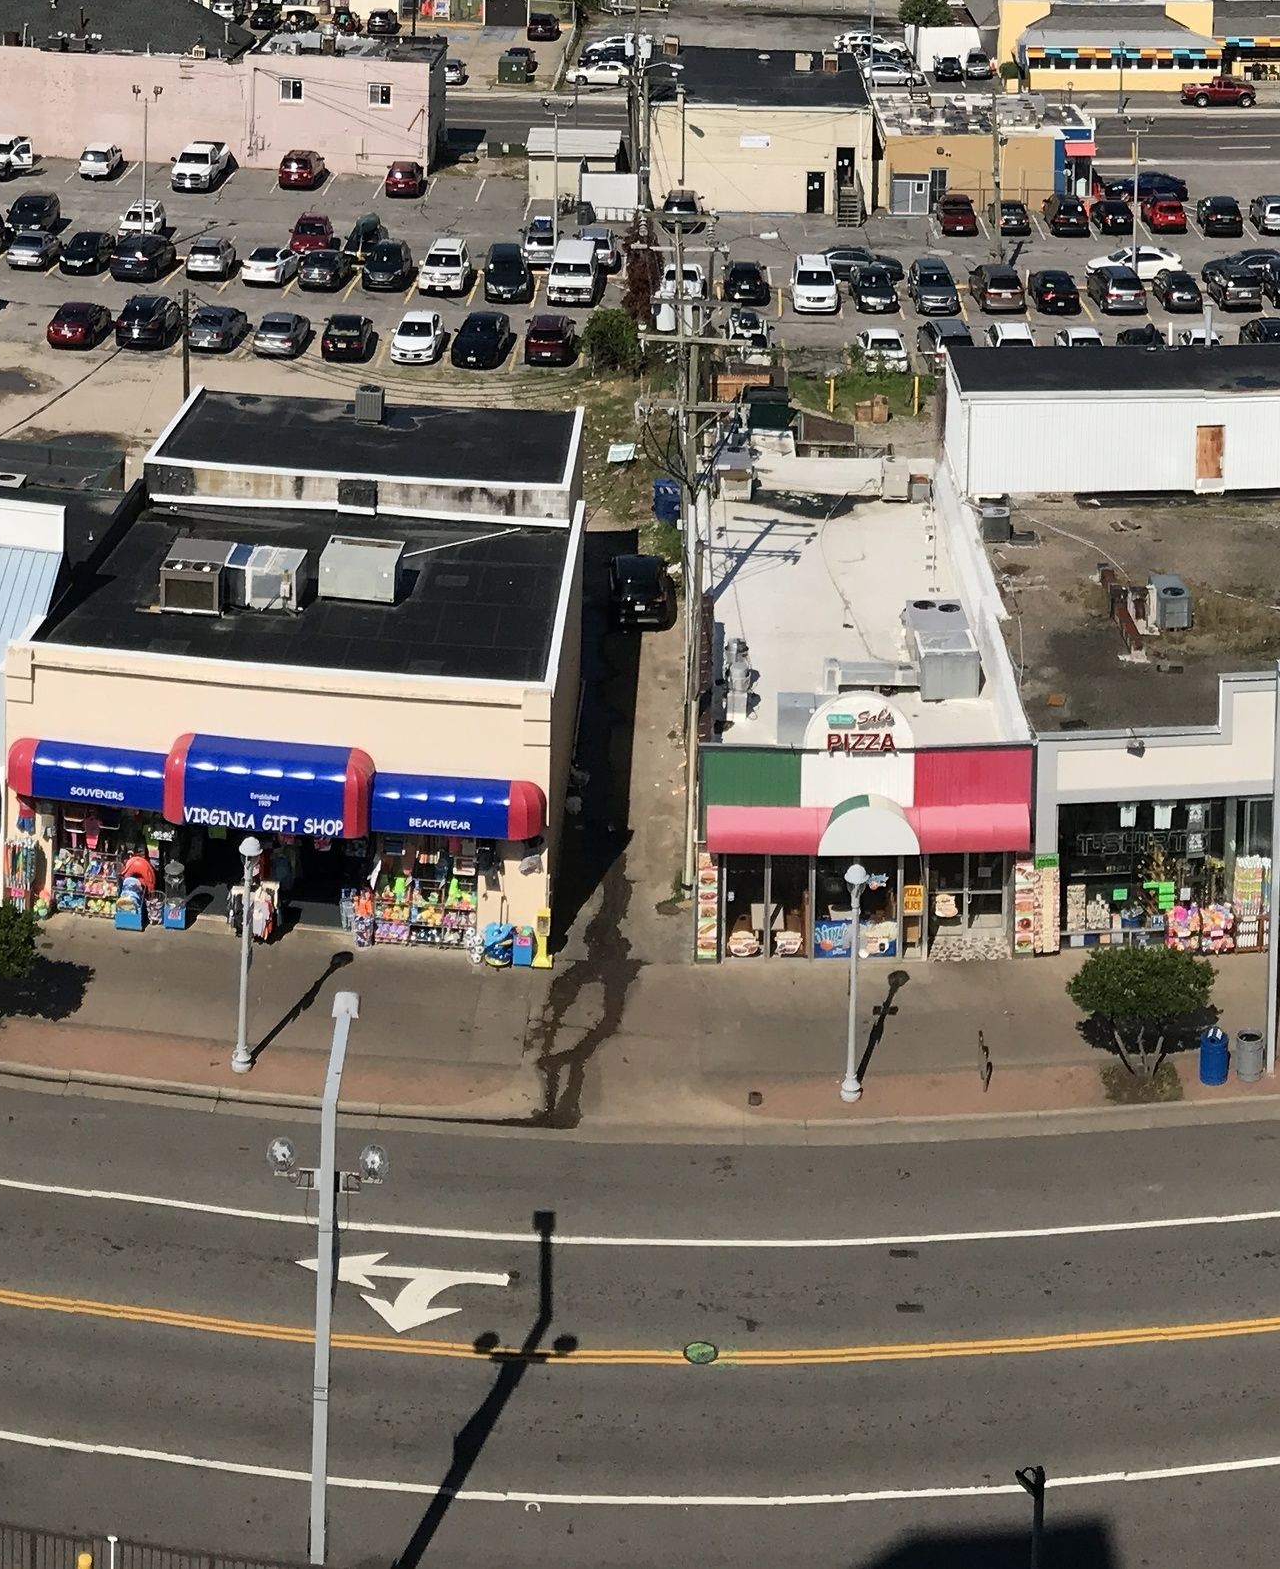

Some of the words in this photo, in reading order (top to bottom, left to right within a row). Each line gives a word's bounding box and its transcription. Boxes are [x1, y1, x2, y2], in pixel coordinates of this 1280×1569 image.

[827, 733, 896, 751] PIZZA
[70, 786, 125, 801] SOUVENIRS
[184, 806, 256, 830] VIRGINIA
[261, 814, 299, 833] GIFT
[303, 818, 344, 836] SHOP
[409, 818, 471, 830] BEACHWEAR
